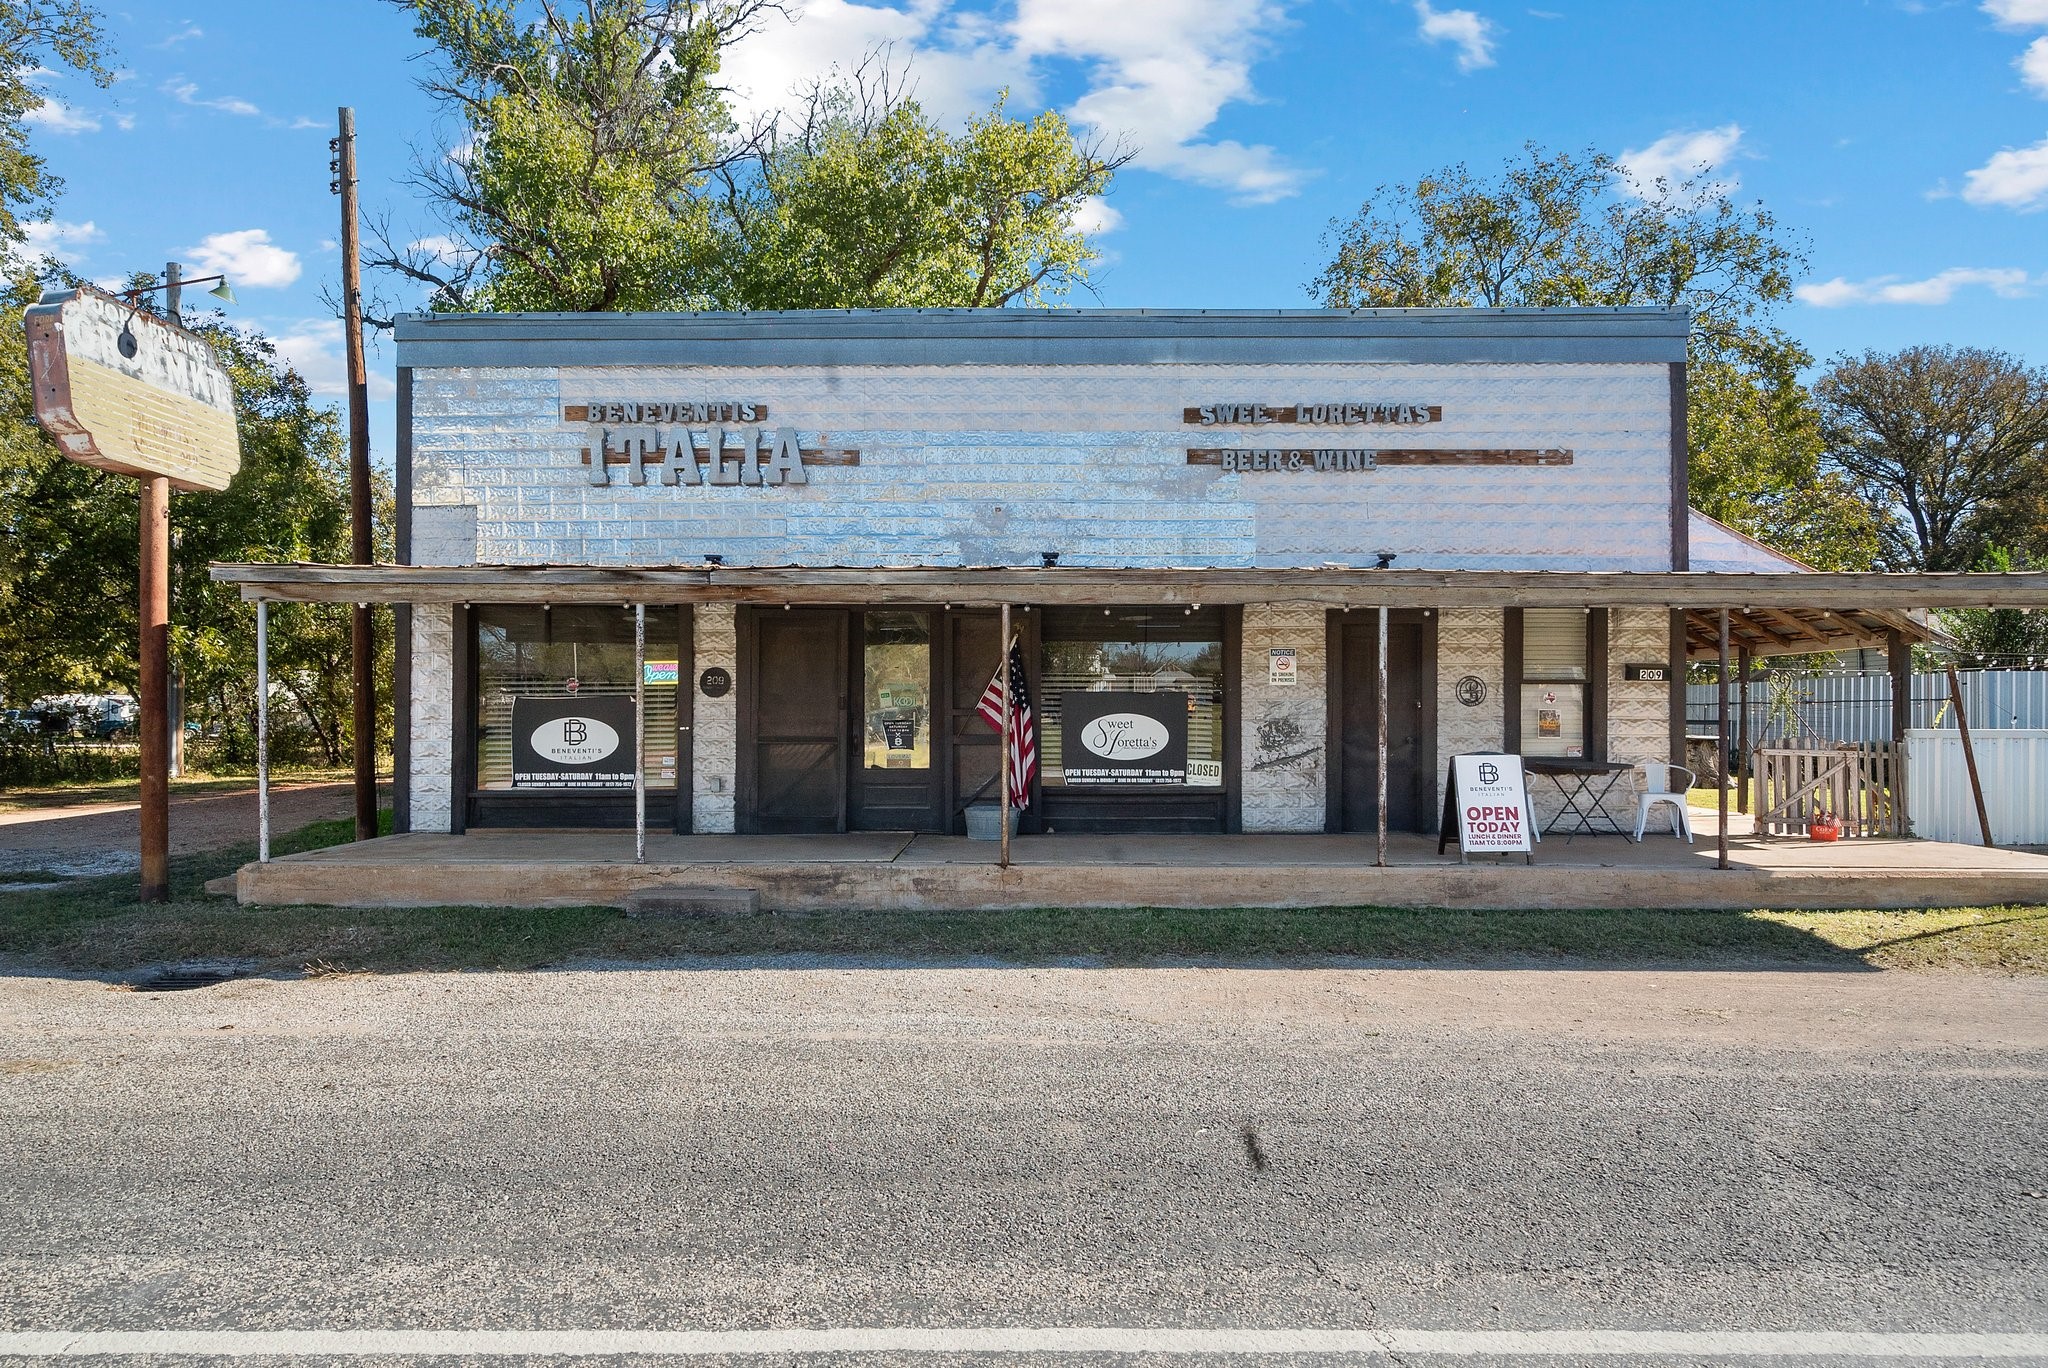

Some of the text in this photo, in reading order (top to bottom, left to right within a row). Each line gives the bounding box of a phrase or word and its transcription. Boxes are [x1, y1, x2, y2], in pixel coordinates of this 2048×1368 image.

[587, 402, 757, 423] BENEVENTIS
[1296, 403, 1431, 424] LORETTAS
[587, 427, 807, 486] ITALIA
[1221, 450, 1378, 471] BEER & WINE
[707, 676, 724, 685] 209
[1640, 670, 1662, 680] 209
[1093, 719, 1134, 748] Sweet
[1187, 763, 1220, 777] CLOSED
[1467, 807, 1519, 820] OPEN
[1468, 822, 1520, 832] TODAY
